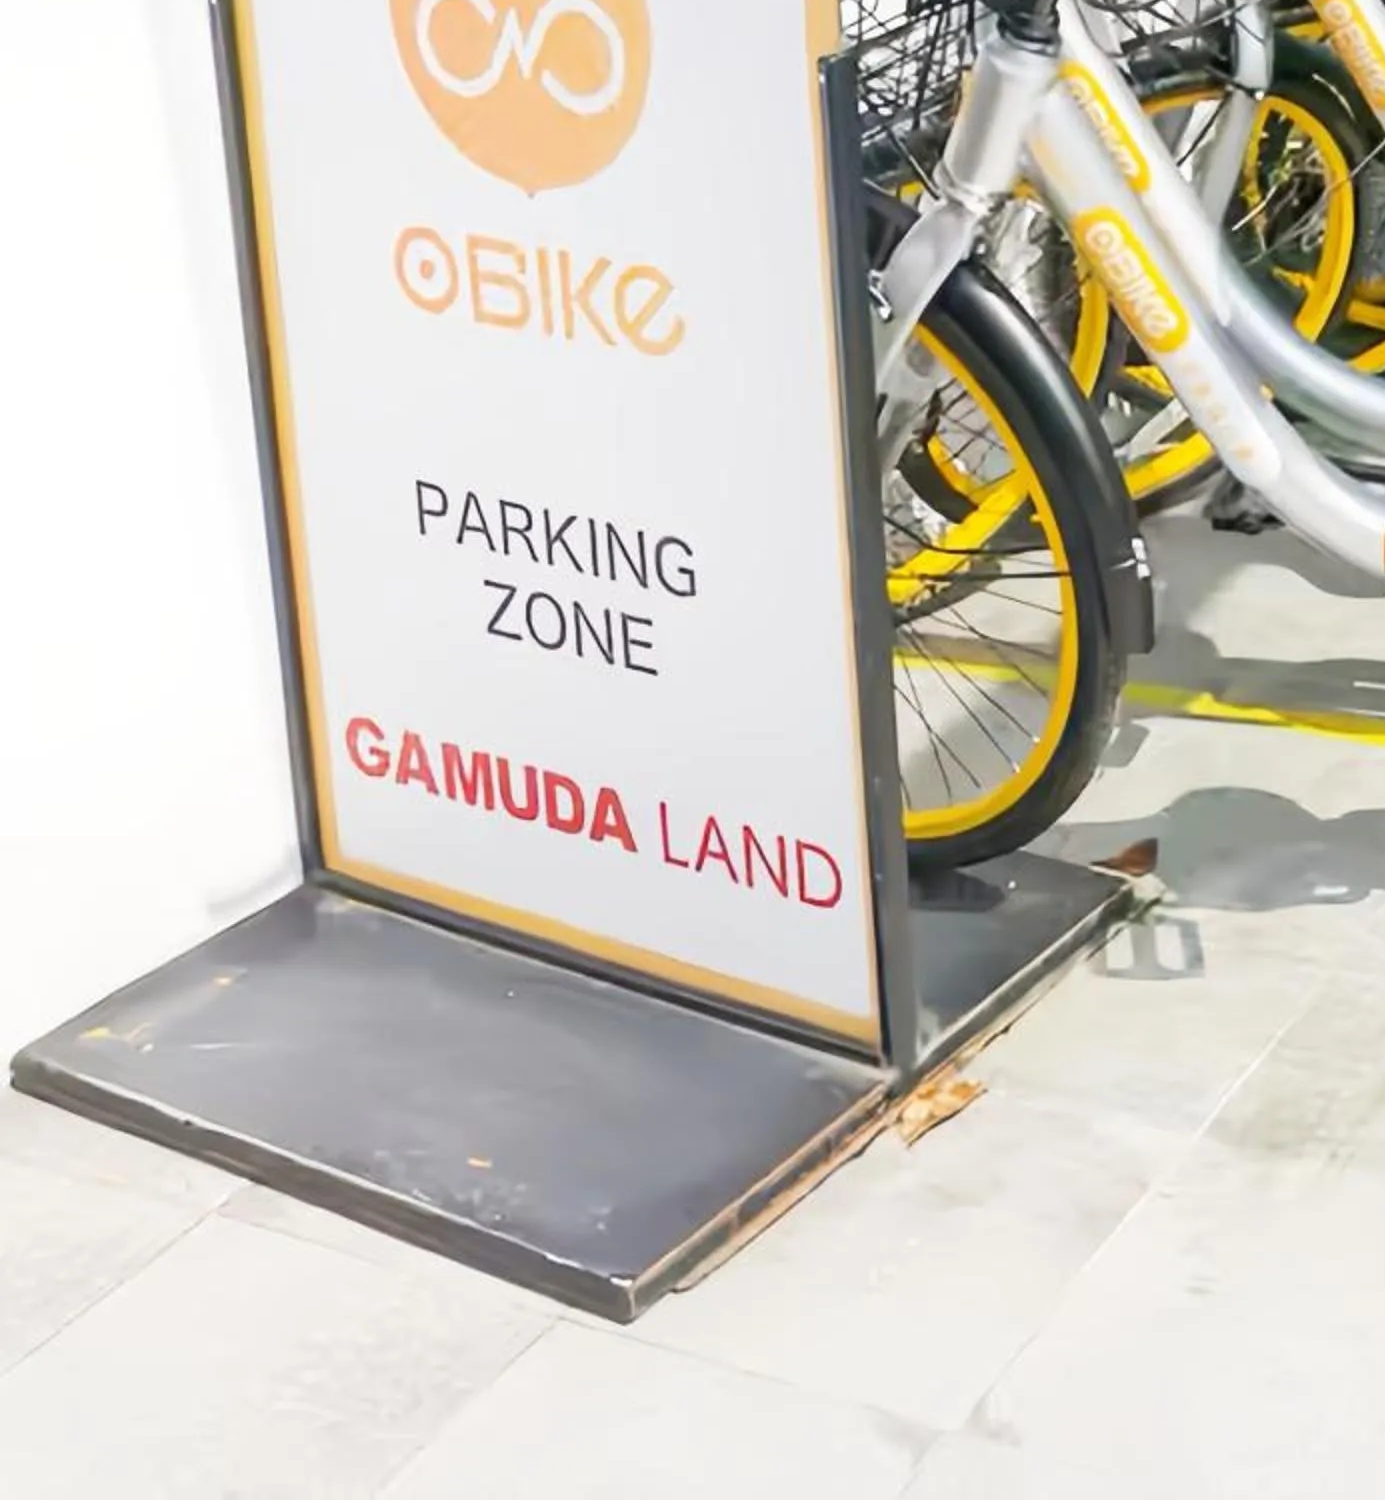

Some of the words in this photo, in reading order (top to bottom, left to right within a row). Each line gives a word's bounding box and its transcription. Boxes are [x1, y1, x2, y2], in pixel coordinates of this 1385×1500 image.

[415, 480, 697, 597] PARKING
[483, 579, 659, 677] ZONE
[344, 716, 638, 854] GAMUDA
[658, 801, 843, 909] LAND
